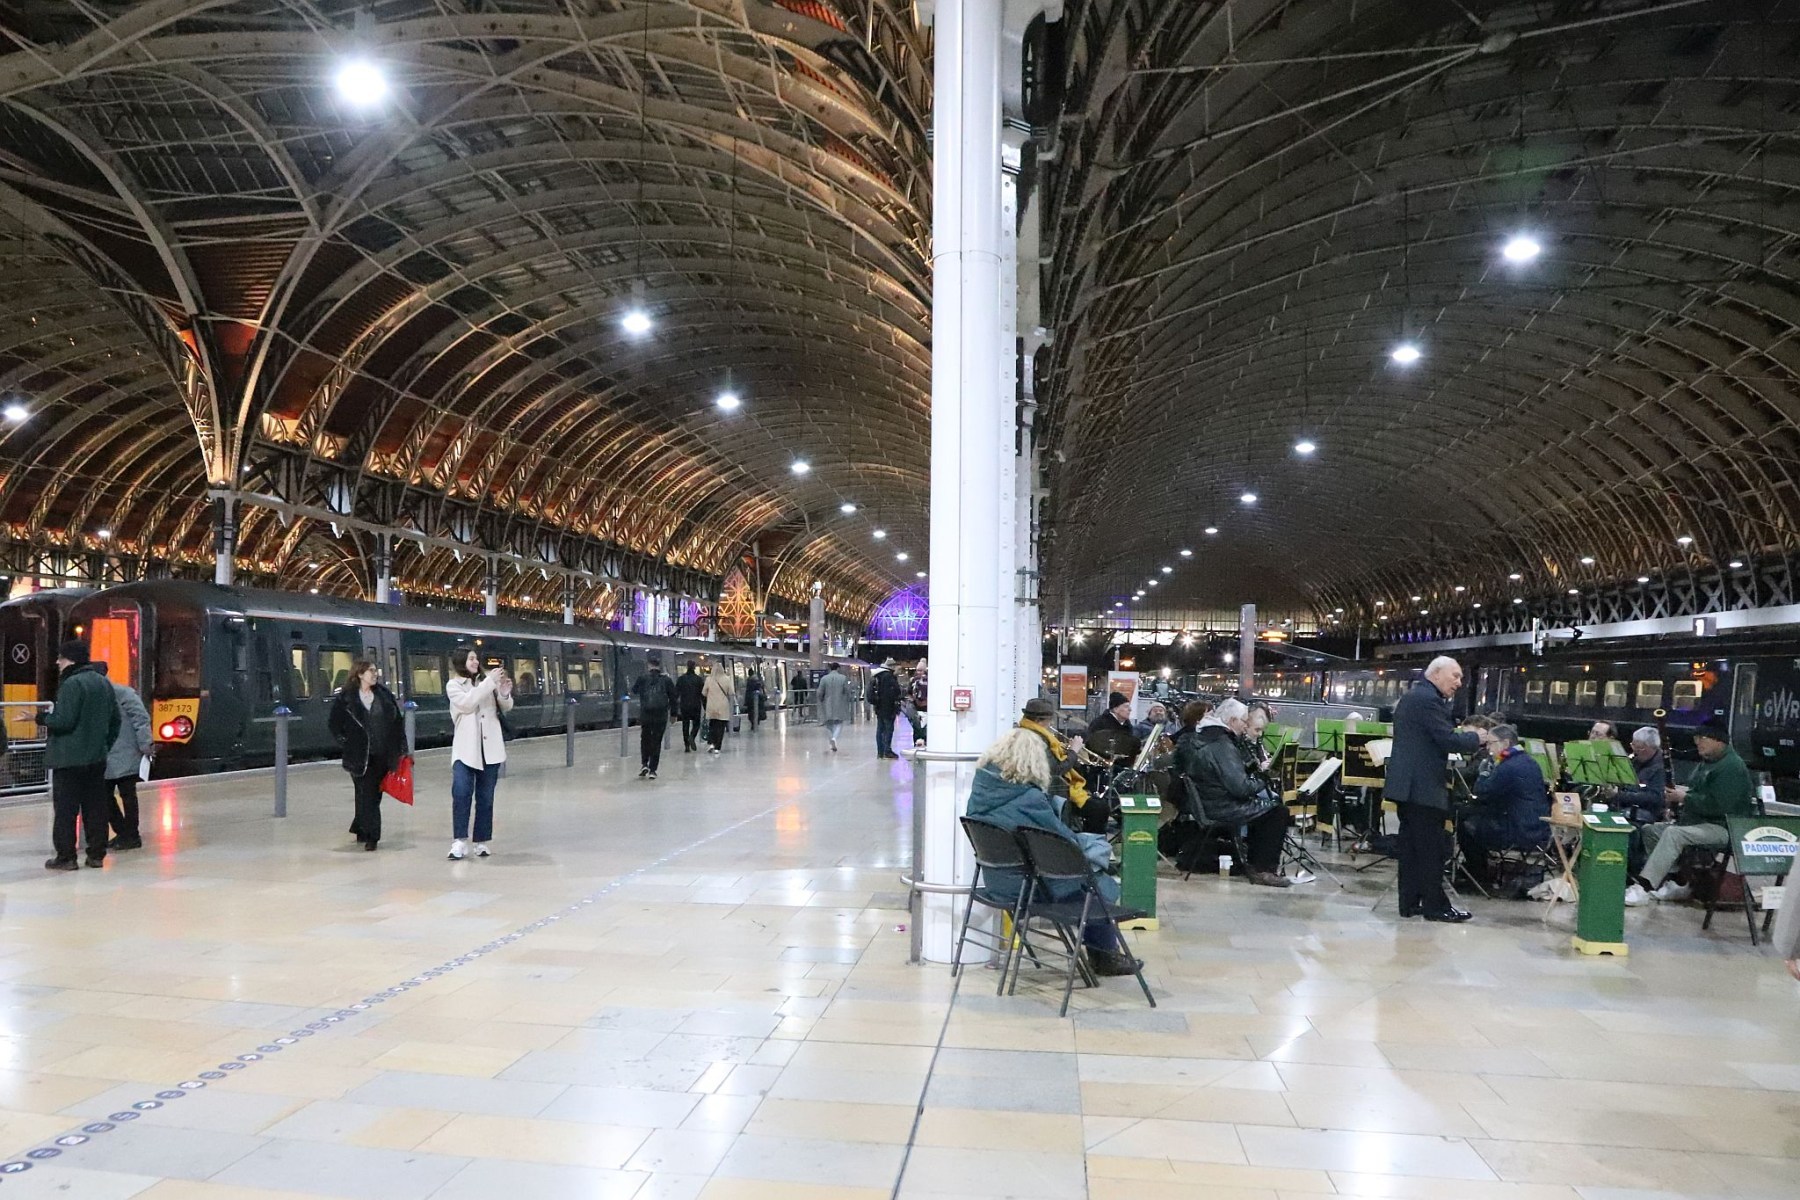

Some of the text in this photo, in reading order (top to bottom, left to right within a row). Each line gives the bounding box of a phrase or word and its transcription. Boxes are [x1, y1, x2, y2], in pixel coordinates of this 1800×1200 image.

[159, 703, 192, 713] 387 173
[1764, 687, 1800, 726] GWR
